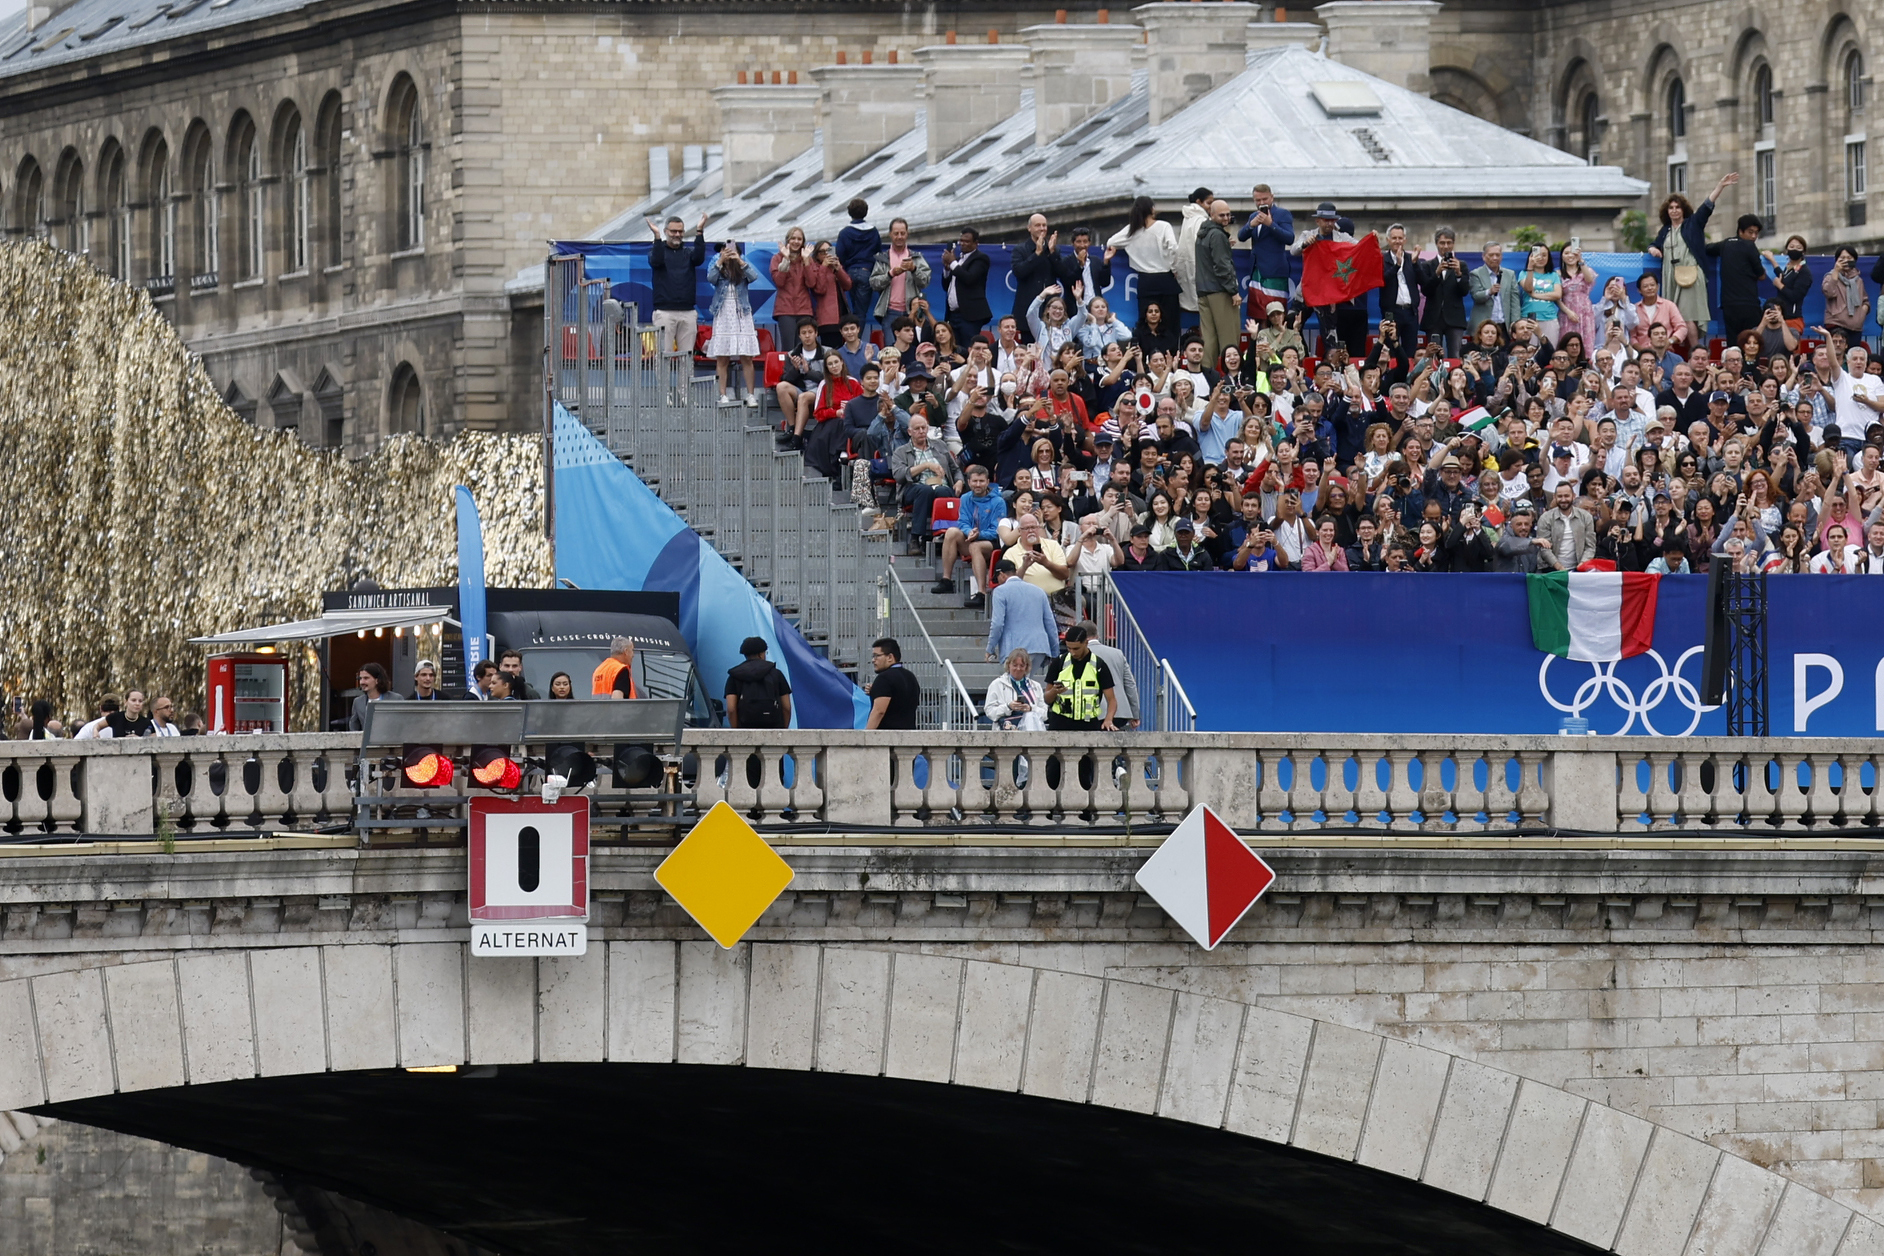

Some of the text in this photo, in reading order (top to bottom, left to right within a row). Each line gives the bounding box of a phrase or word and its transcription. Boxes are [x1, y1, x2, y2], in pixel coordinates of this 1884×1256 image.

[348, 592, 431, 609] SANDWICH ARTISANAL
[532, 636, 545, 645] LE
[628, 635, 671, 647] PARISIEN
[479, 932, 579, 948] ALTERNAT
